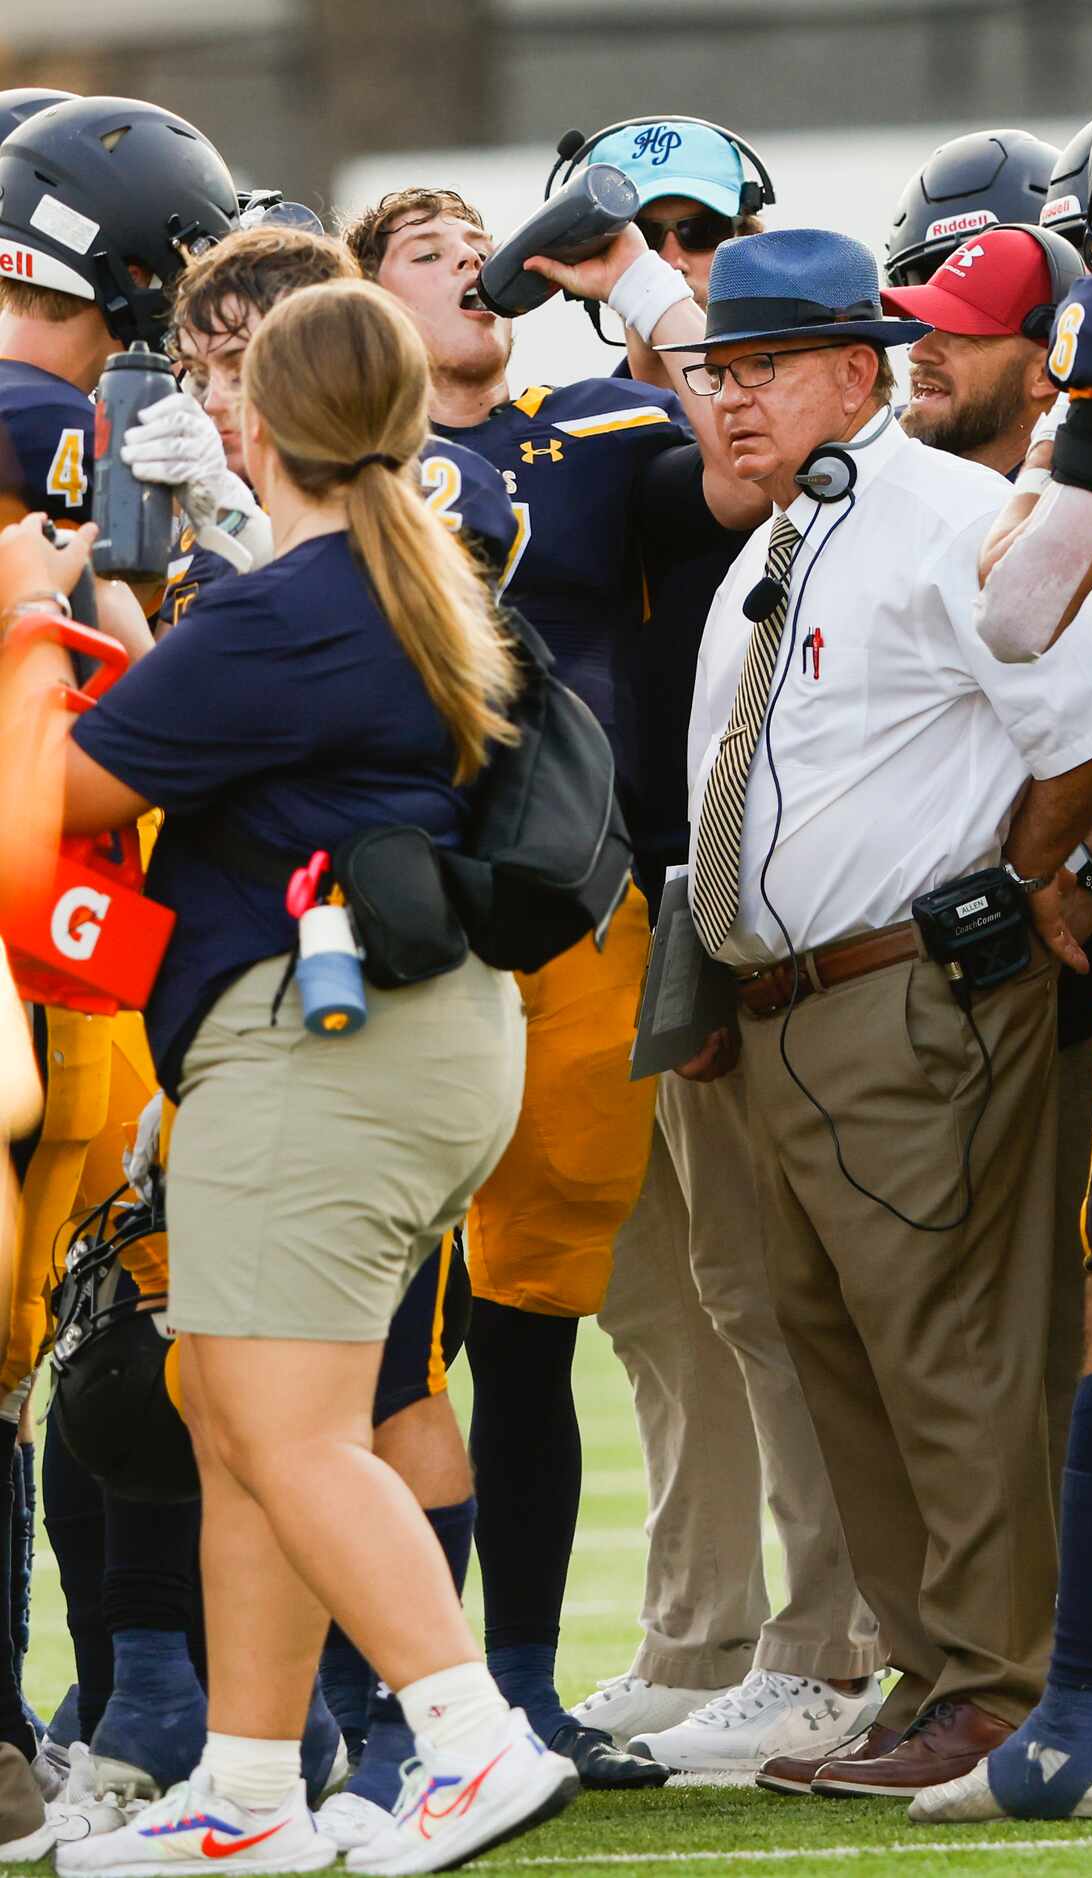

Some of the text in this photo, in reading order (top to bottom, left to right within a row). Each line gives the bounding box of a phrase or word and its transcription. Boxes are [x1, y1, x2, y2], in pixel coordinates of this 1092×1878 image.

[632, 126, 682, 166] HP
[932, 213, 988, 237] Riddell
[1048, 302, 1086, 382] 6
[46, 428, 88, 508] 4
[51, 886, 112, 961] G
[961, 899, 985, 914] ALLEN
